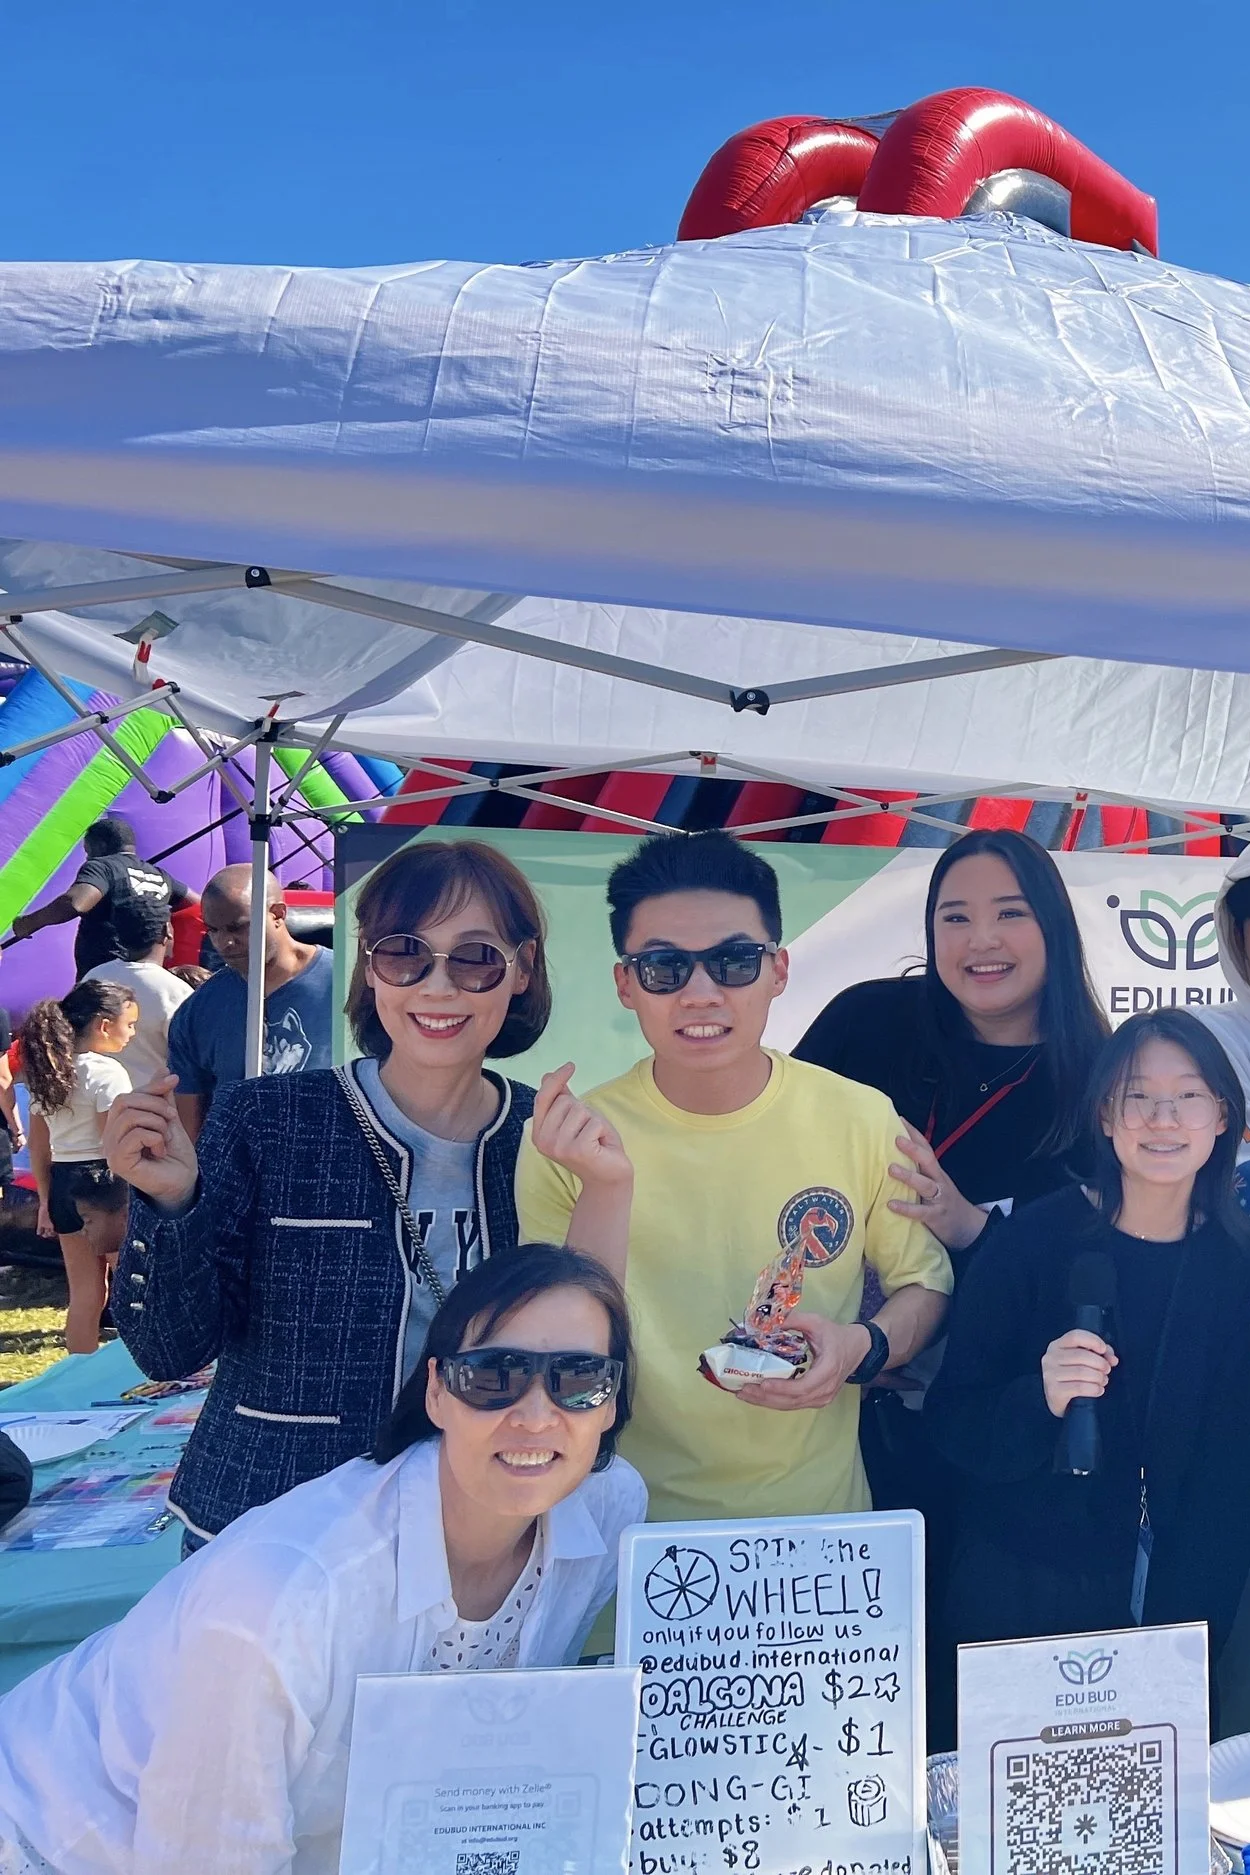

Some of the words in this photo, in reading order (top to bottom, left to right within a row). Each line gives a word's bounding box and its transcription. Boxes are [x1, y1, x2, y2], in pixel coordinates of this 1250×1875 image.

[1111, 987, 1177, 1013] EDU
[725, 1568, 884, 1621] WHEEL!
[642, 1626, 685, 1647] only
[689, 1625, 703, 1643] if
[706, 1625, 750, 1646] you
[757, 1621, 825, 1641] follow
[835, 1624, 863, 1639] us
[1055, 1692, 1085, 1707] EDU
[1088, 1689, 1117, 1704] BUD
[680, 1709, 787, 1731] CHALLENGE
[1051, 1724, 1087, 1737] LEARN
[1089, 1720, 1121, 1733] MORE
[837, 1716, 894, 1756] $1
[434, 1788, 460, 1798] Send
[462, 1787, 496, 1797] money
[499, 1784, 520, 1794] with
[434, 1826, 468, 1835] EDUBUD
[468, 1823, 531, 1833] INTERNATIONAL
[532, 1822, 546, 1830] INC
